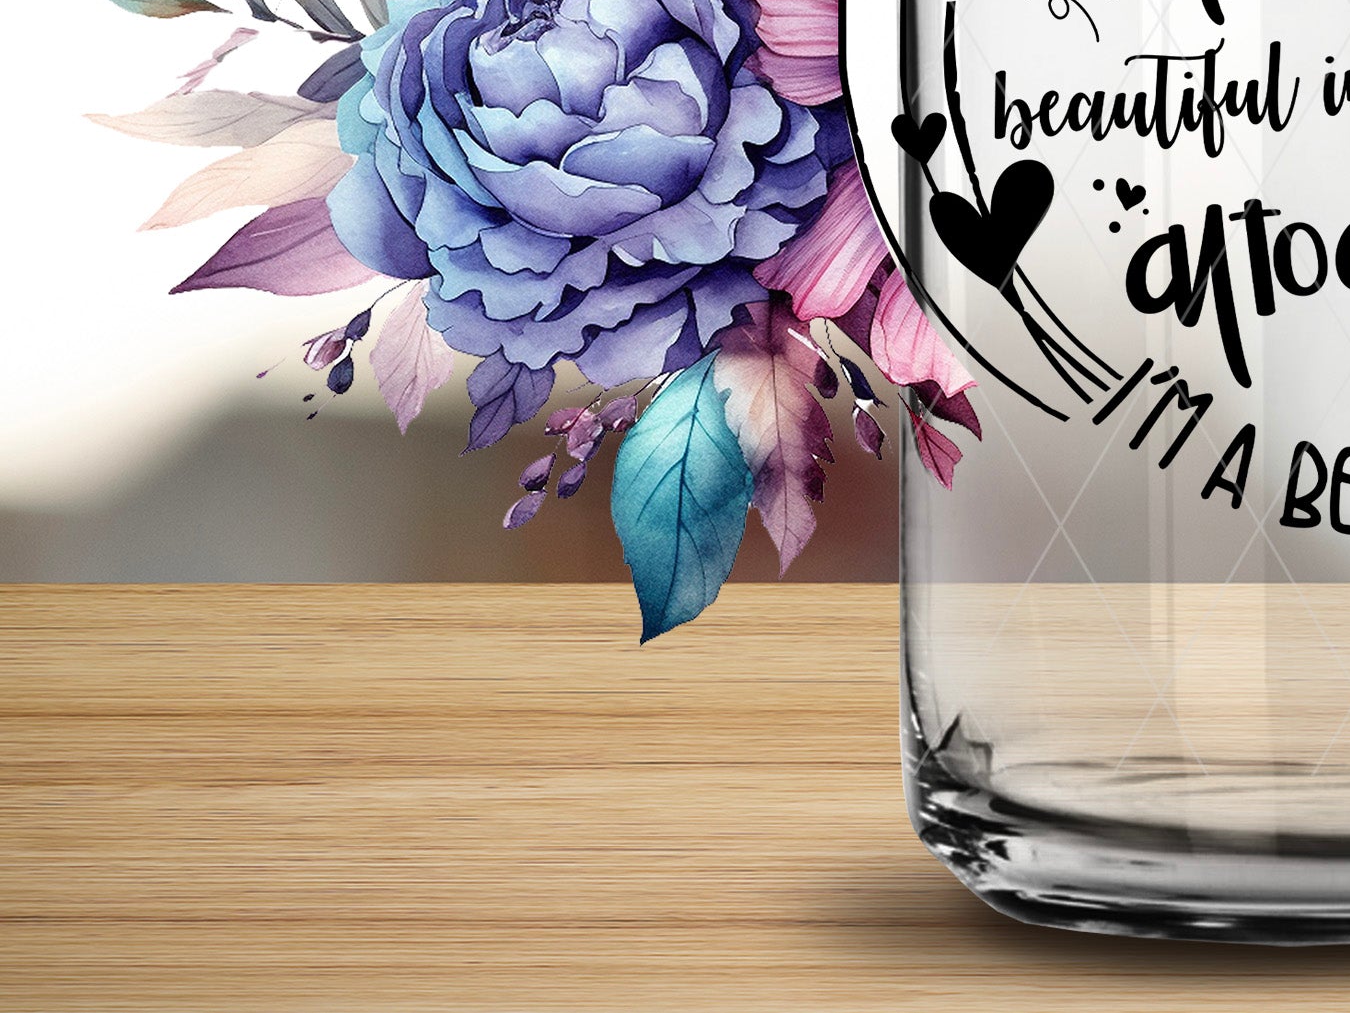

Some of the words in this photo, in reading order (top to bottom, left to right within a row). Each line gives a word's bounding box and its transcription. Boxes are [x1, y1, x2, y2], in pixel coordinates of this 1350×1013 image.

[994, 38, 1299, 157] beautiful
[1092, 357, 1213, 470] I'M
[1200, 423, 1257, 510] A
